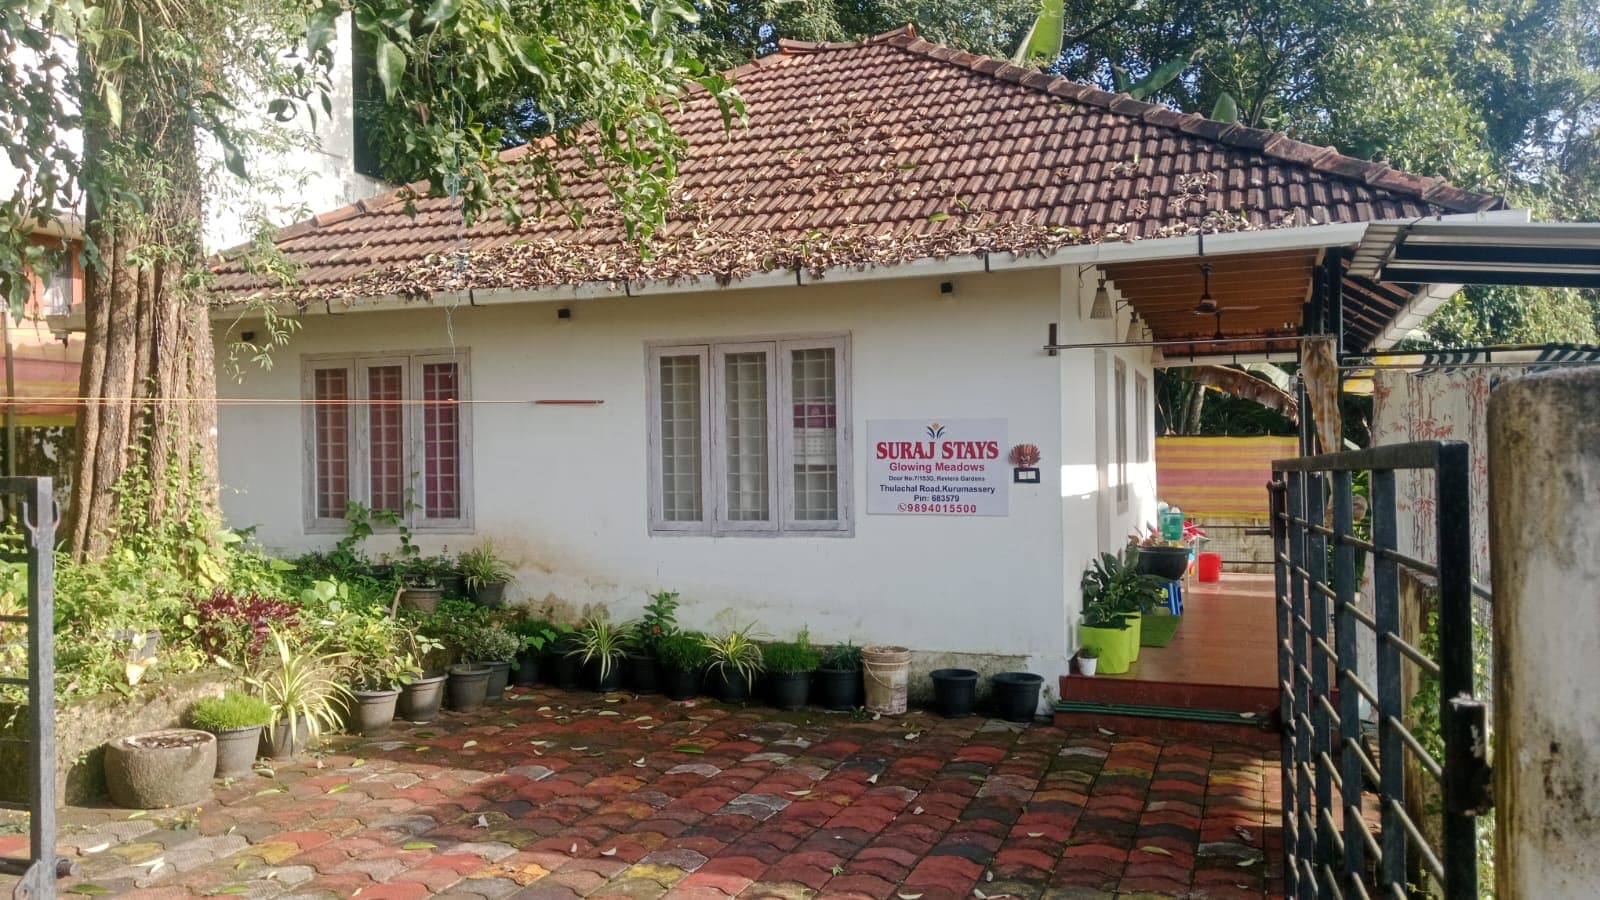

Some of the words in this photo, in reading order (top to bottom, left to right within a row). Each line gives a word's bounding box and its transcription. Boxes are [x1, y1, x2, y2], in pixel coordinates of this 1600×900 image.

[876, 441, 936, 460] SURAJ
[941, 440, 999, 460] STAYS
[889, 462, 932, 474] Glowing
[935, 462, 985, 472] Meadows
[880, 484, 918, 493] Thulachal
[907, 503, 977, 513] 9894015500
